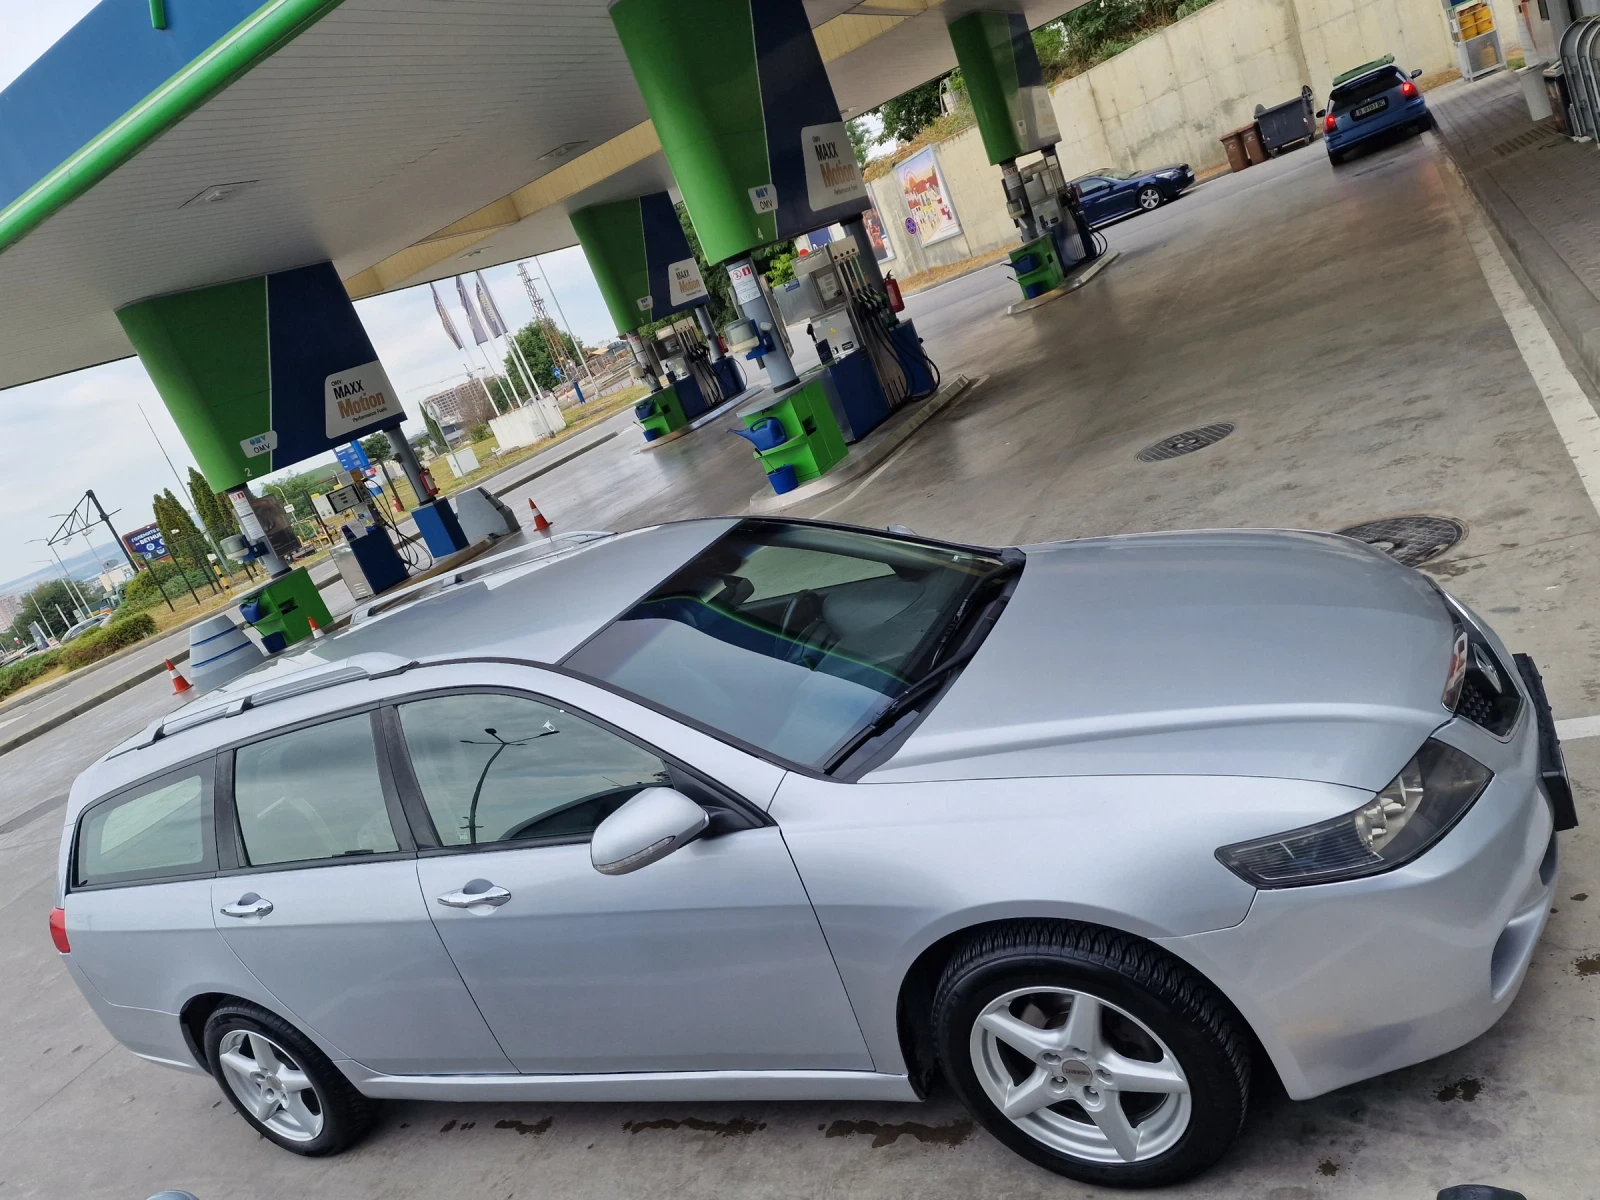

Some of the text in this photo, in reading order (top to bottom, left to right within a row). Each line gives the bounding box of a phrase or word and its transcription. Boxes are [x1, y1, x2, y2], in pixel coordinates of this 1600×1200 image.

[814, 142, 838, 161] MAXX
[820, 160, 856, 188] Motion
[760, 199, 772, 210] OMV
[757, 227, 764, 240] 4
[679, 278, 700, 294] Motion
[331, 379, 342, 387] OMV
[333, 380, 364, 400] MAXX
[337, 392, 386, 419] Motion
[353, 406, 388, 423] Performance Fuels
[253, 442, 270, 454] OMV
[244, 467, 252, 477] 2
